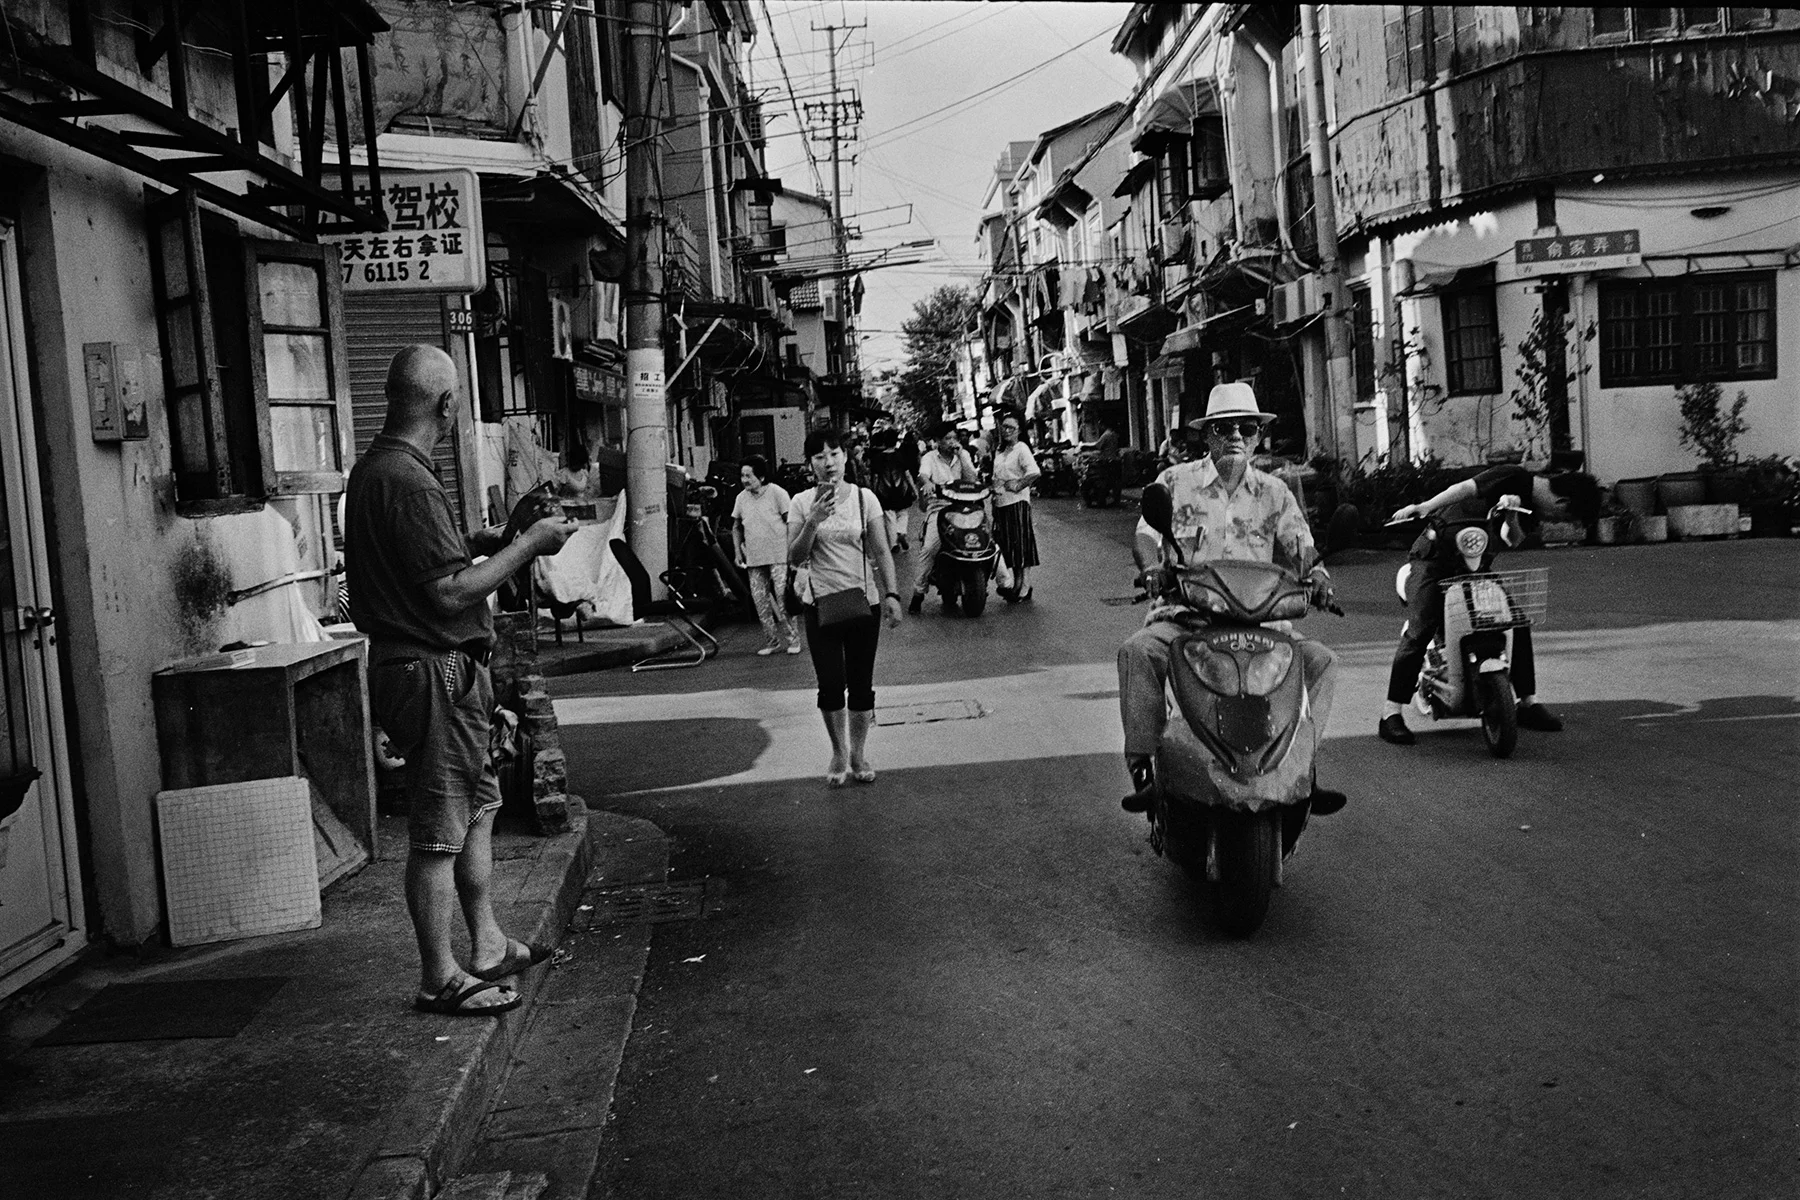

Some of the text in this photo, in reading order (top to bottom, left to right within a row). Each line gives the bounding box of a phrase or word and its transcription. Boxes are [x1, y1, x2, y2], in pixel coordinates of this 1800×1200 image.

[364, 261, 409, 283] 6115
[419, 260, 430, 281] 2
[450, 311, 472, 325] 306
